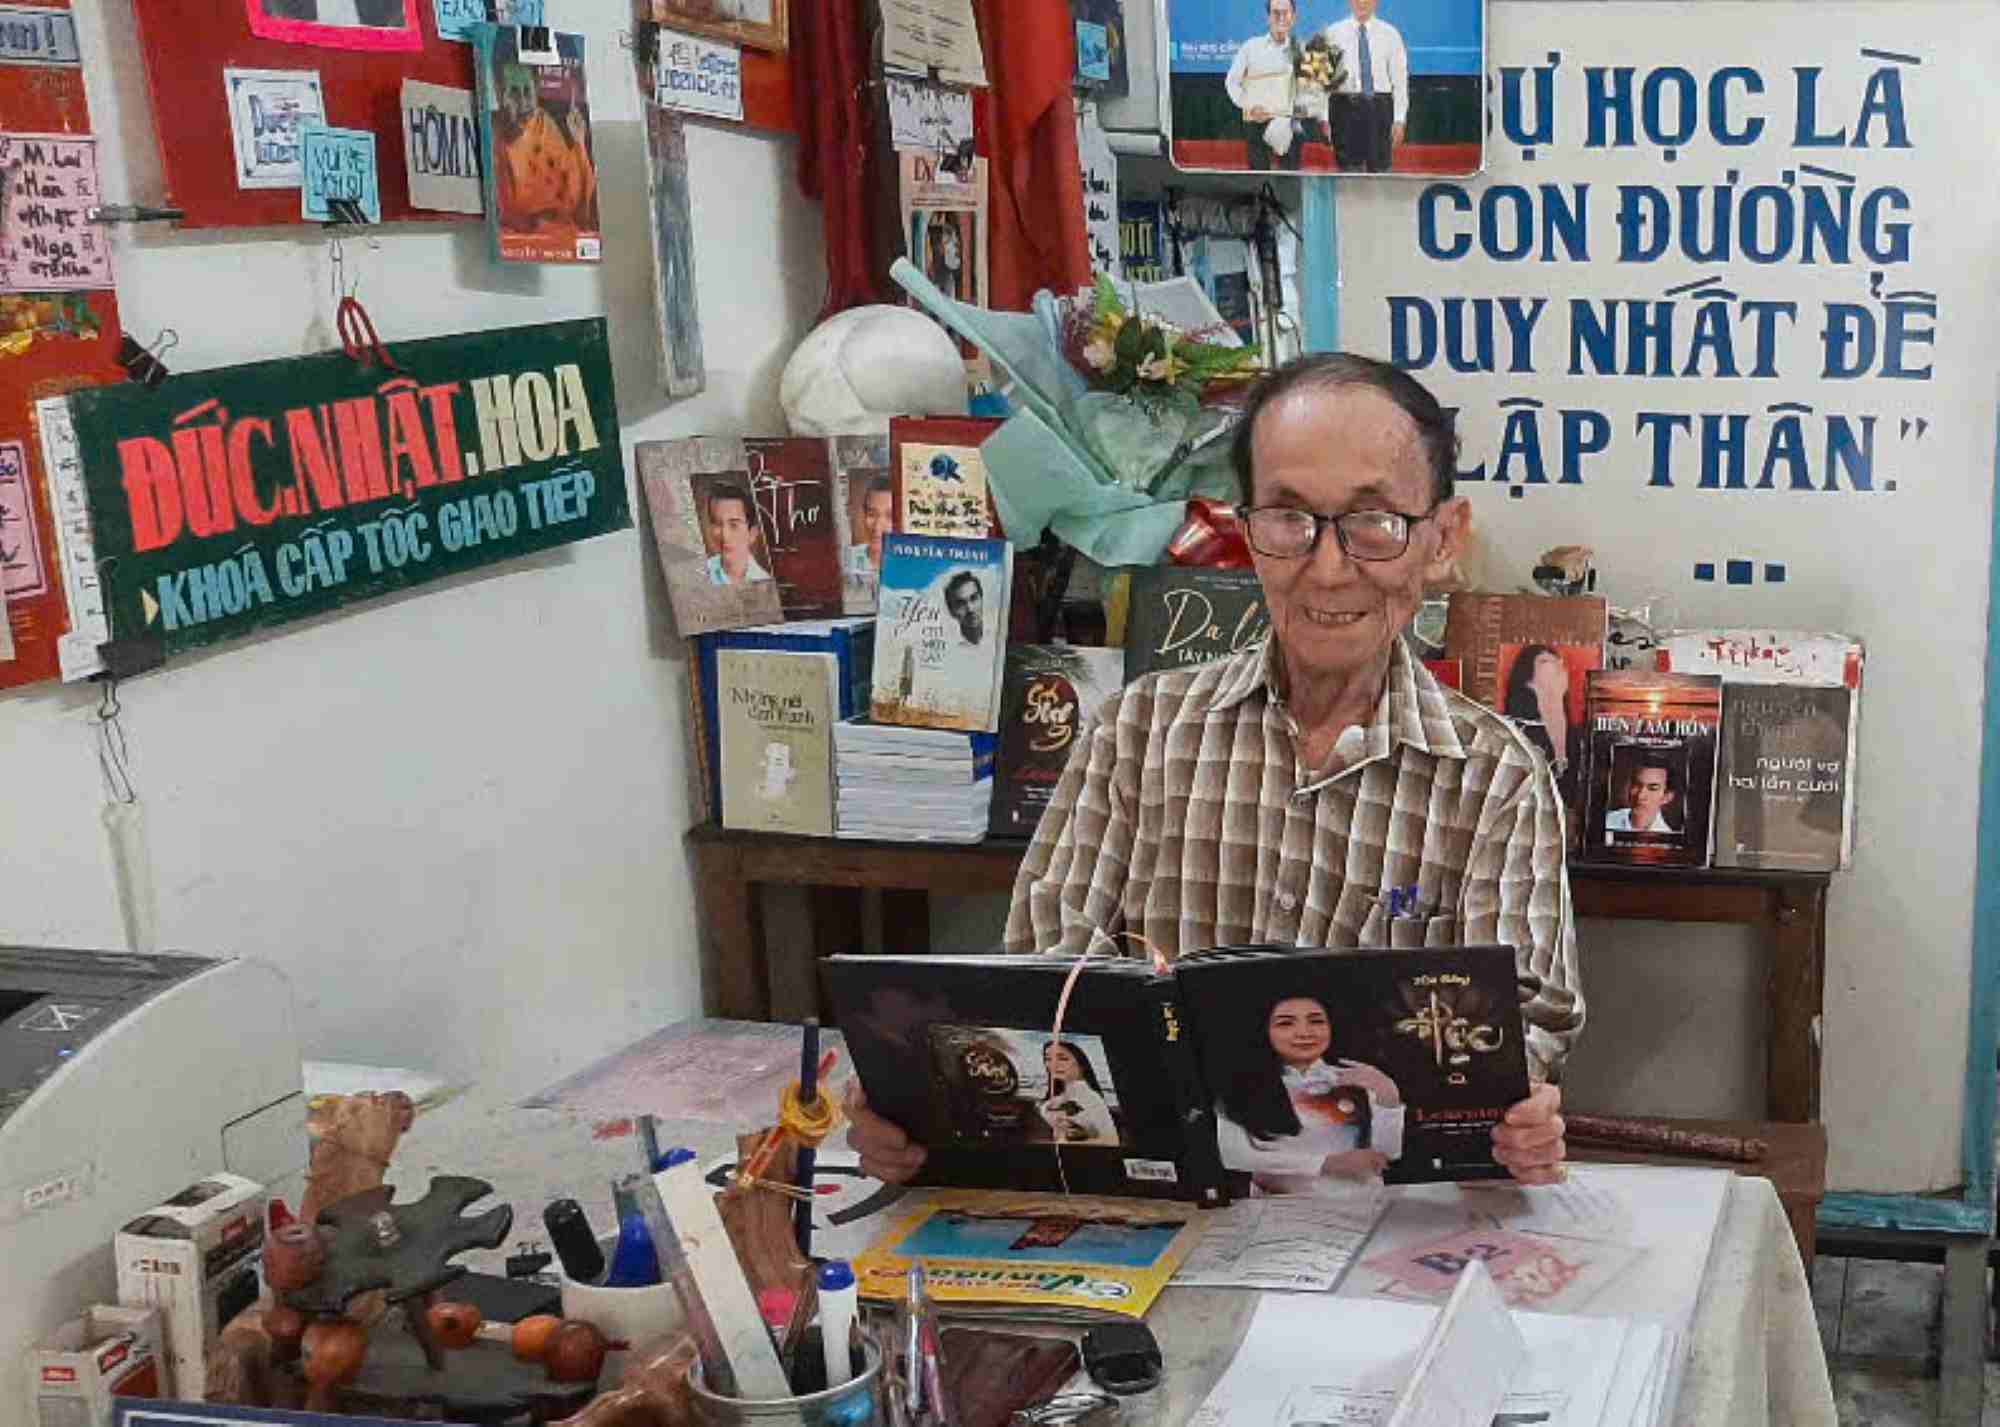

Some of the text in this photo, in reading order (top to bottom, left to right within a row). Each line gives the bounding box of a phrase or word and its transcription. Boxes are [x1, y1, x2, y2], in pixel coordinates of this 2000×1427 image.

[1487, 48, 1921, 162] Ự HỌC LÀ
[1417, 164, 1914, 264] CON ĐƯỜNG
[1386, 271, 1937, 381] DUY NHẤT ĐỂ
[156, 461, 597, 631] KHOÁ CẤP TỐC GIAO TIẾP
